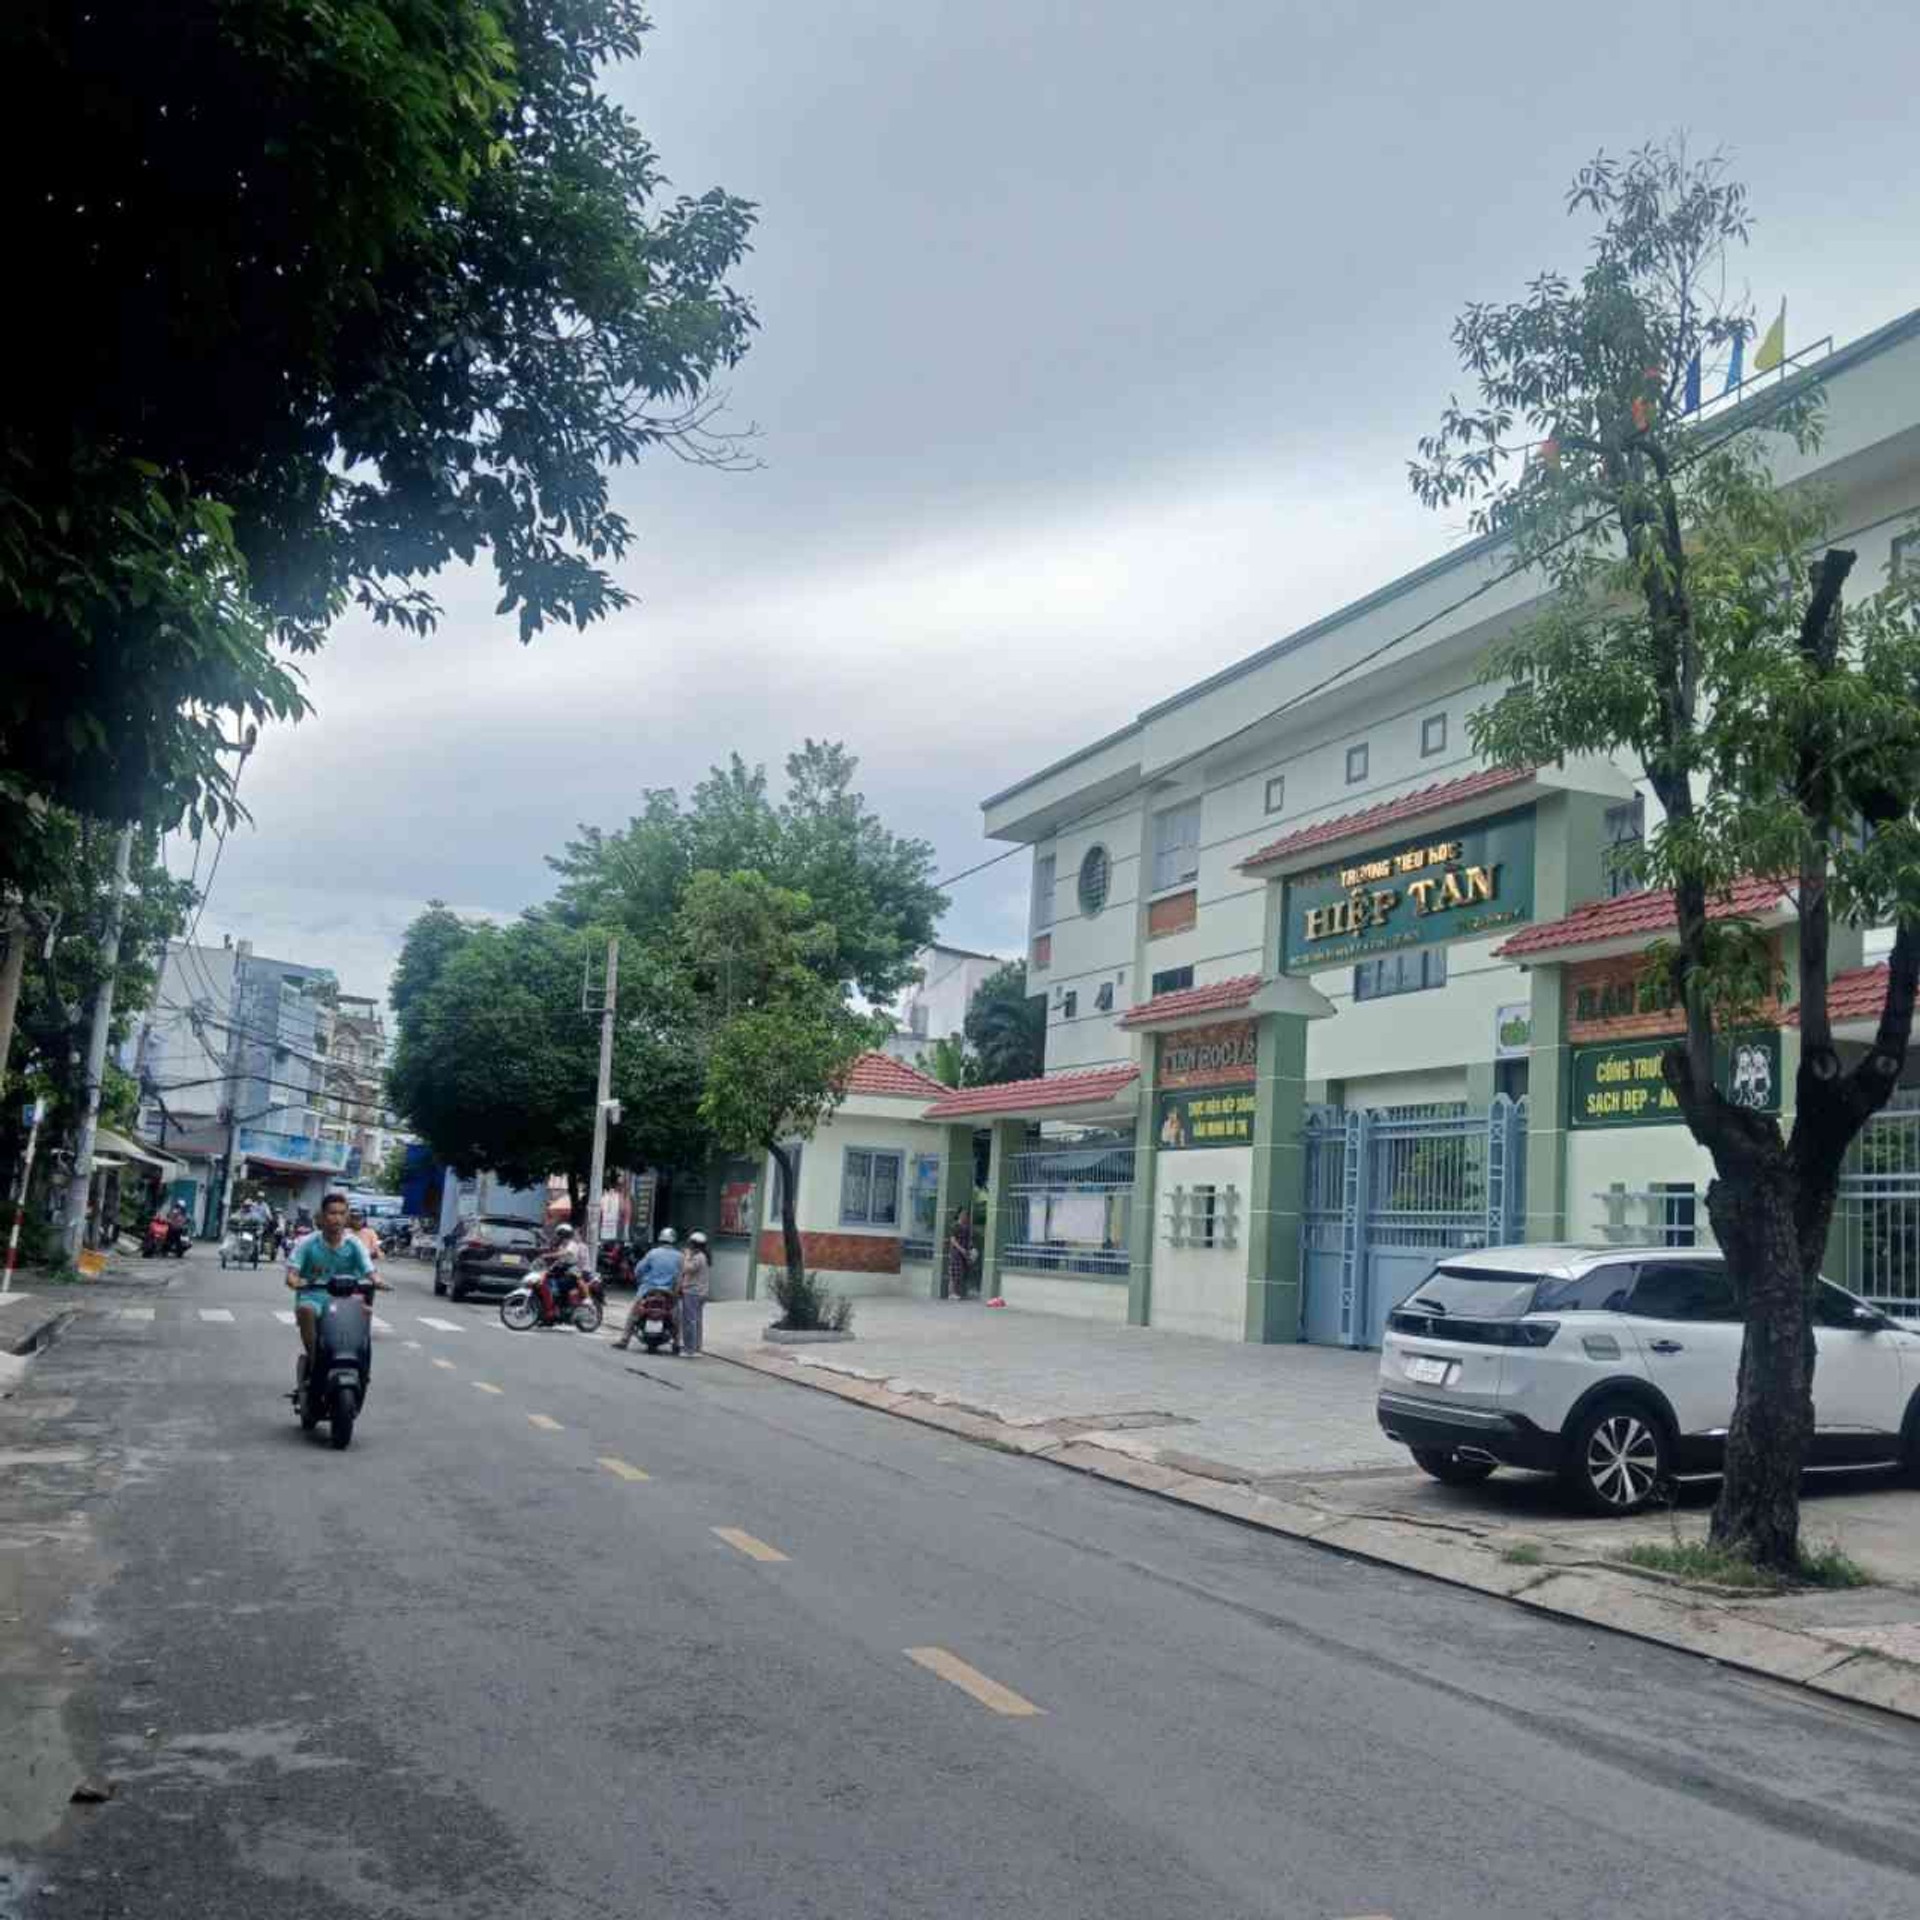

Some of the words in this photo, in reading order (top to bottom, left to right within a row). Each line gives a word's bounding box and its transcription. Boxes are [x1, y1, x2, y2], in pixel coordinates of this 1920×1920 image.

[1304, 888, 1397, 941] HIỆP
[1408, 864, 1500, 917] TÂN
[1587, 1091, 1620, 1118] SẠCH
[1622, 1088, 1648, 1116] ĐẸP
